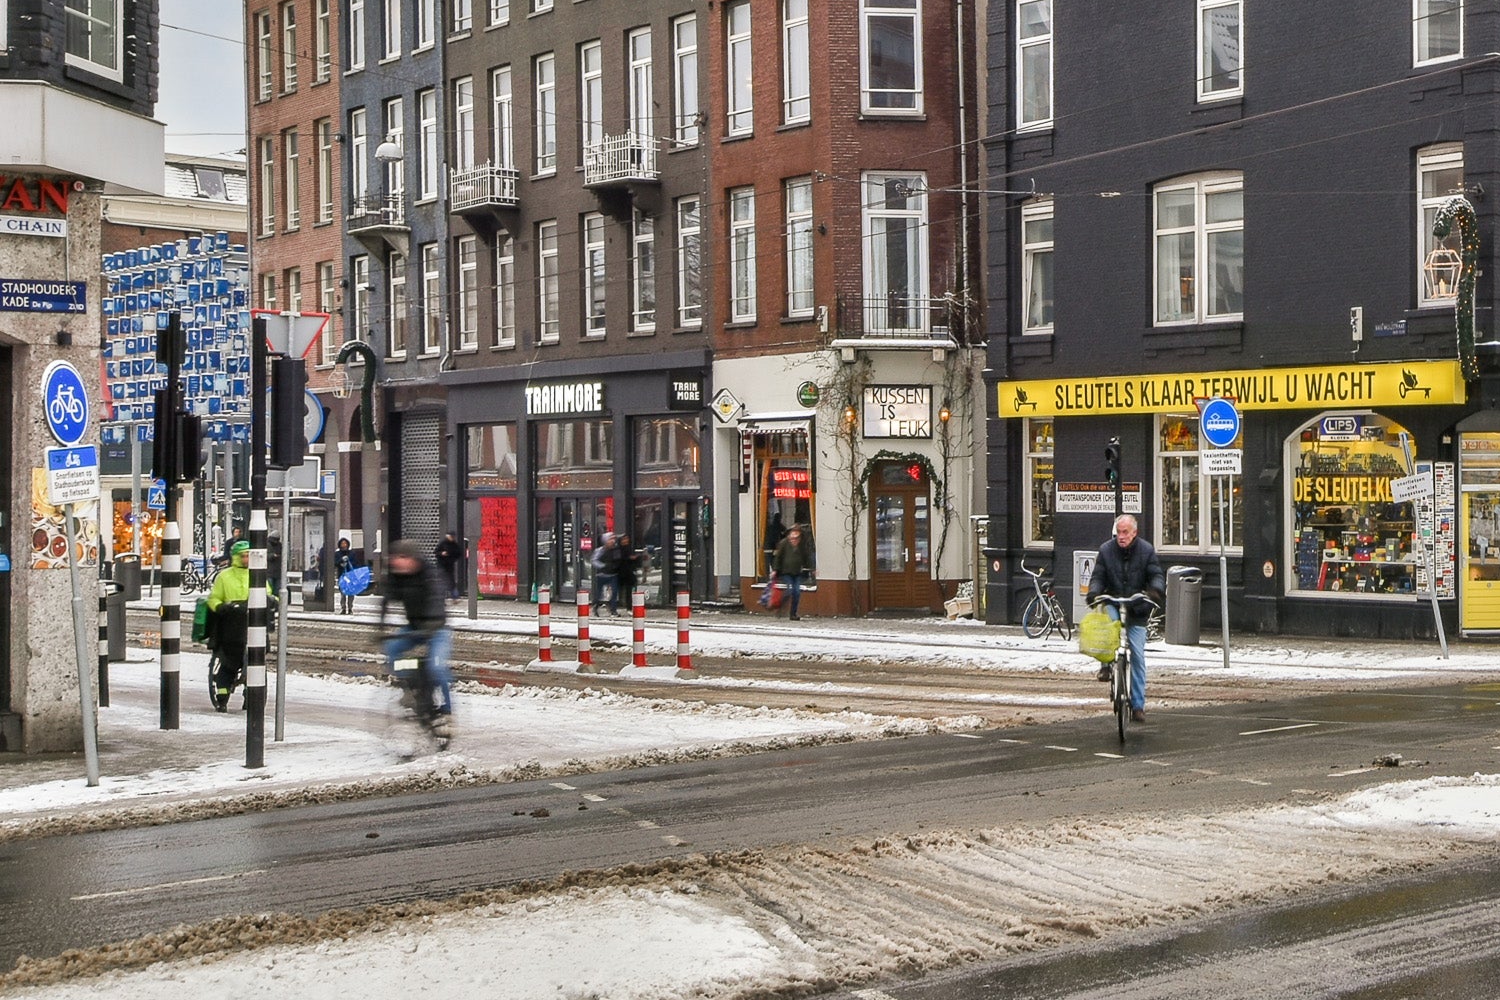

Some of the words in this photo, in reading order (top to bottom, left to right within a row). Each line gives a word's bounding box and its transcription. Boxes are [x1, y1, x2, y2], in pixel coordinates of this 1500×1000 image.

[7, 219, 62, 233] CHAIN
[1, 282, 78, 296] STADHOUDERS
[2, 297, 30, 308] KADE
[673, 381, 698, 391] TRAIN
[1055, 381, 1134, 410] SLEUTELS
[1140, 378, 1195, 408] KLAAR
[1200, 375, 1279, 404] TERWIJL
[1286, 374, 1298, 402] U
[1304, 371, 1376, 401] WACHT
[525, 383, 602, 415] TRAINMORE
[676, 391, 700, 401] MORE
[872, 387, 924, 405] KUSSEN
[879, 404, 896, 420] IS
[889, 420, 929, 437] LEUK
[1328, 420, 1353, 431] LIPS
[1294, 477, 1313, 502] DE
[1315, 476, 1398, 502] SLEUTELKL
